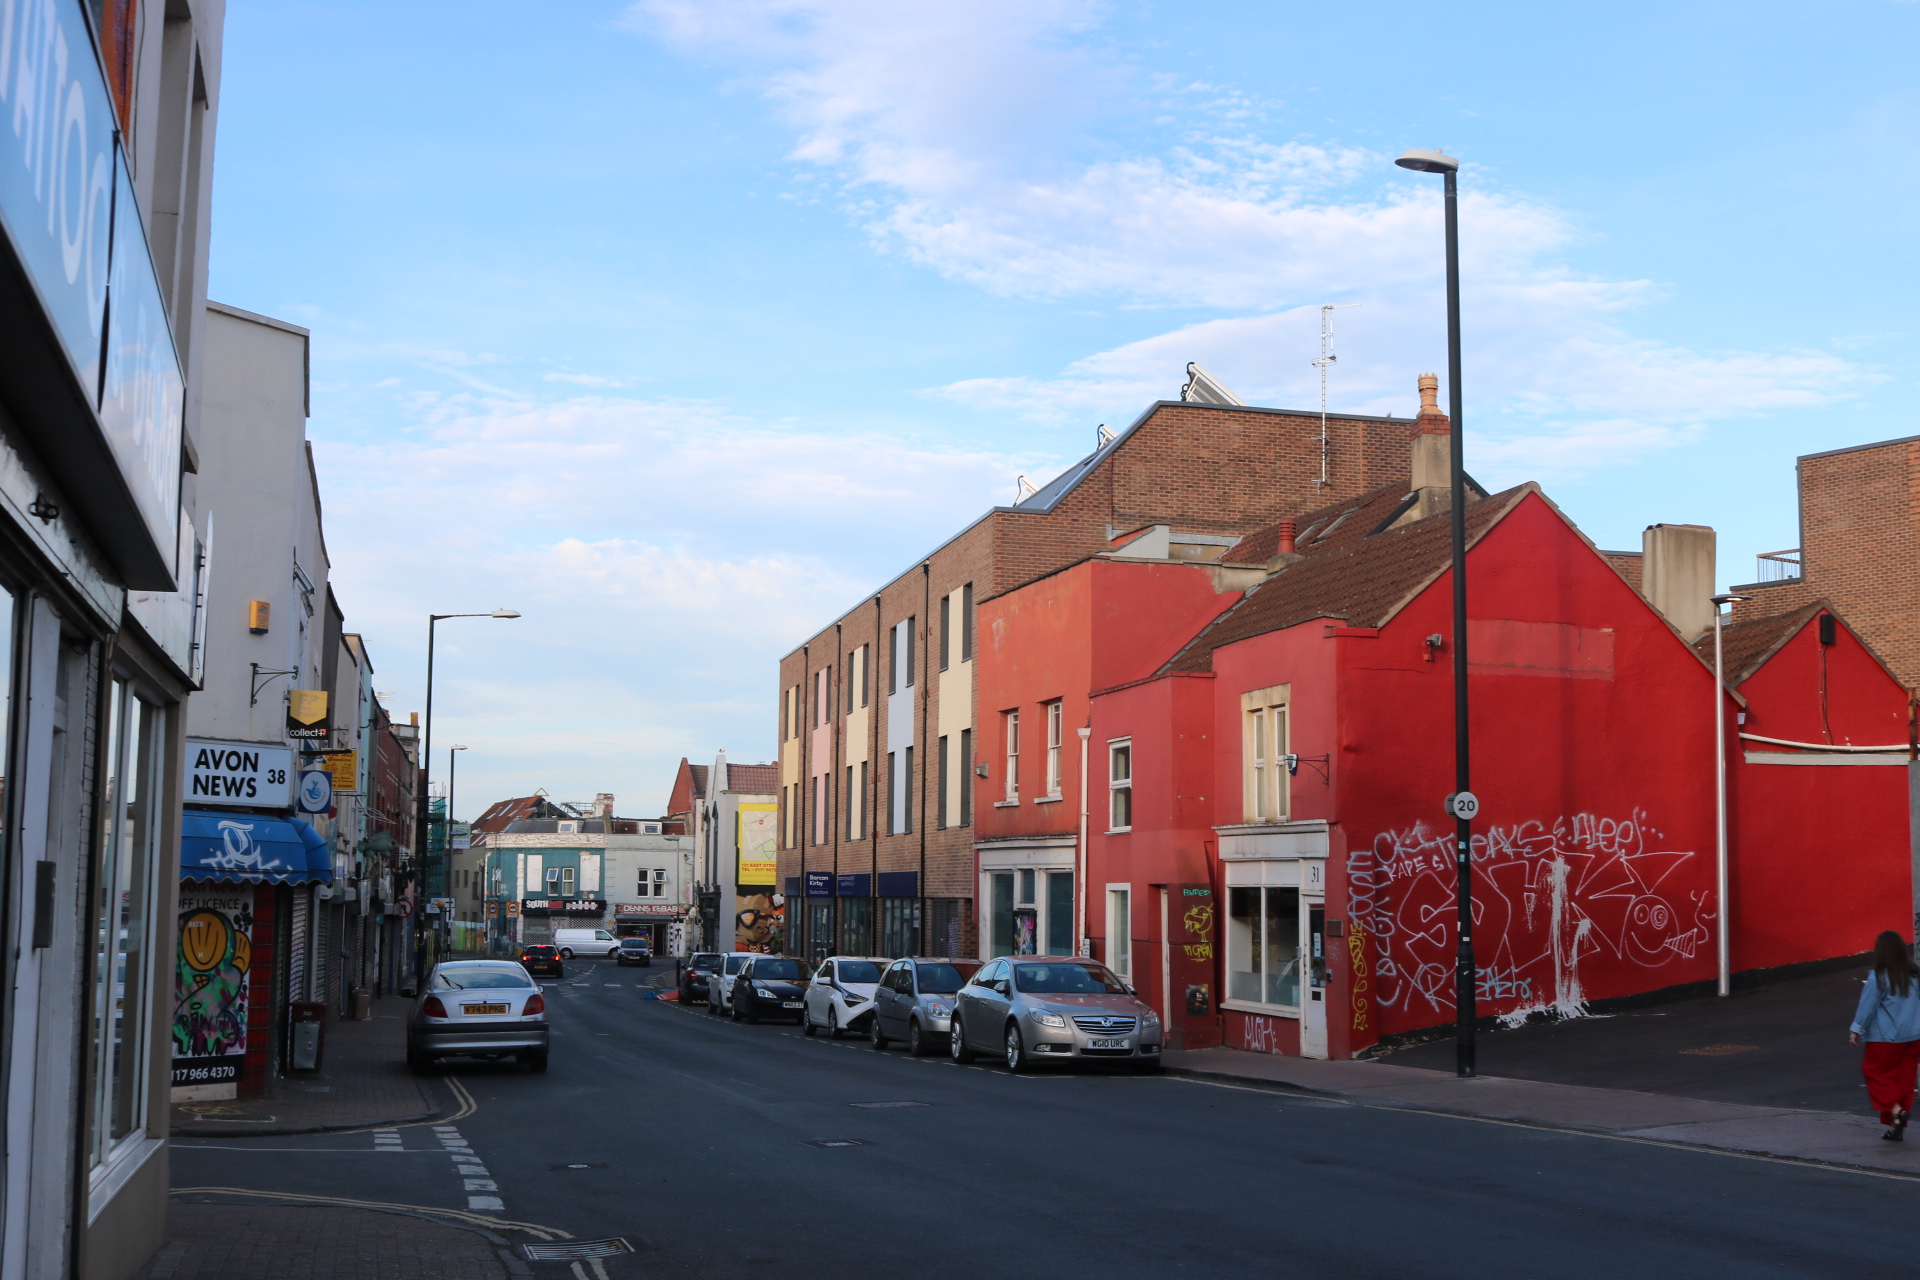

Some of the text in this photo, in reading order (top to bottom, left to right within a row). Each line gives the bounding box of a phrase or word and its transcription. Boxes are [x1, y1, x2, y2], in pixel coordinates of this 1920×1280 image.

[194, 748, 259, 773] AVON
[267, 768, 286, 785] 38
[193, 774, 257, 798] NEWS
[1457, 800, 1475, 812] 20
[1311, 866, 1319, 883] 31
[180, 880, 245, 894] von News
[197, 898, 240, 910] LICENCE
[465, 1004, 506, 1014] V743 PKE
[1092, 1039, 1125, 1048] WG10 URC
[190, 1068, 208, 1080] 966
[210, 1066, 235, 1078] 4370
